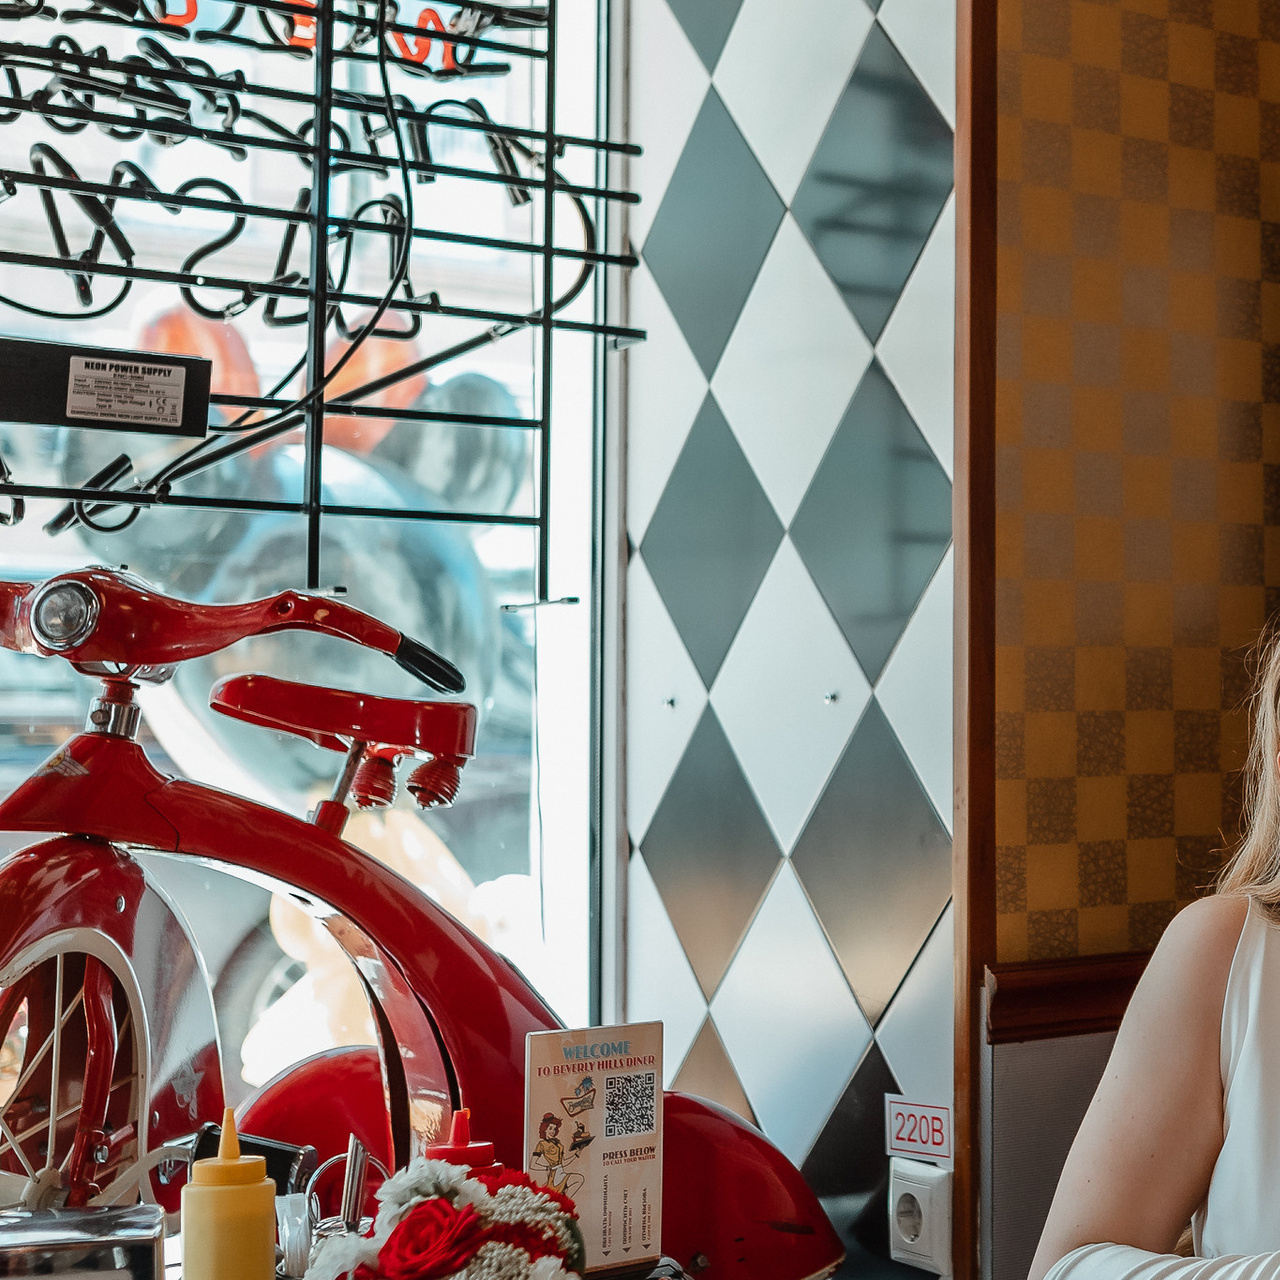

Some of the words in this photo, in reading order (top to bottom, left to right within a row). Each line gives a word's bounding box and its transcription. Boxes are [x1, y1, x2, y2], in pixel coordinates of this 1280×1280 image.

[84, 361, 107, 371] NEON
[109, 364, 139, 374] POWER
[141, 366, 172, 378] SUPPLY
[562, 1040, 632, 1060] WELCOME
[537, 1066, 551, 1077] TO
[553, 1061, 596, 1075] BEVERLY
[597, 1058, 624, 1070] HILLS
[626, 1055, 655, 1067] DINER
[602, 1149, 628, 1161] PRESS
[629, 1145, 657, 1157] BELOW
[610, 1158, 623, 1166] CALL
[638, 1154, 656, 1162] WAITER
